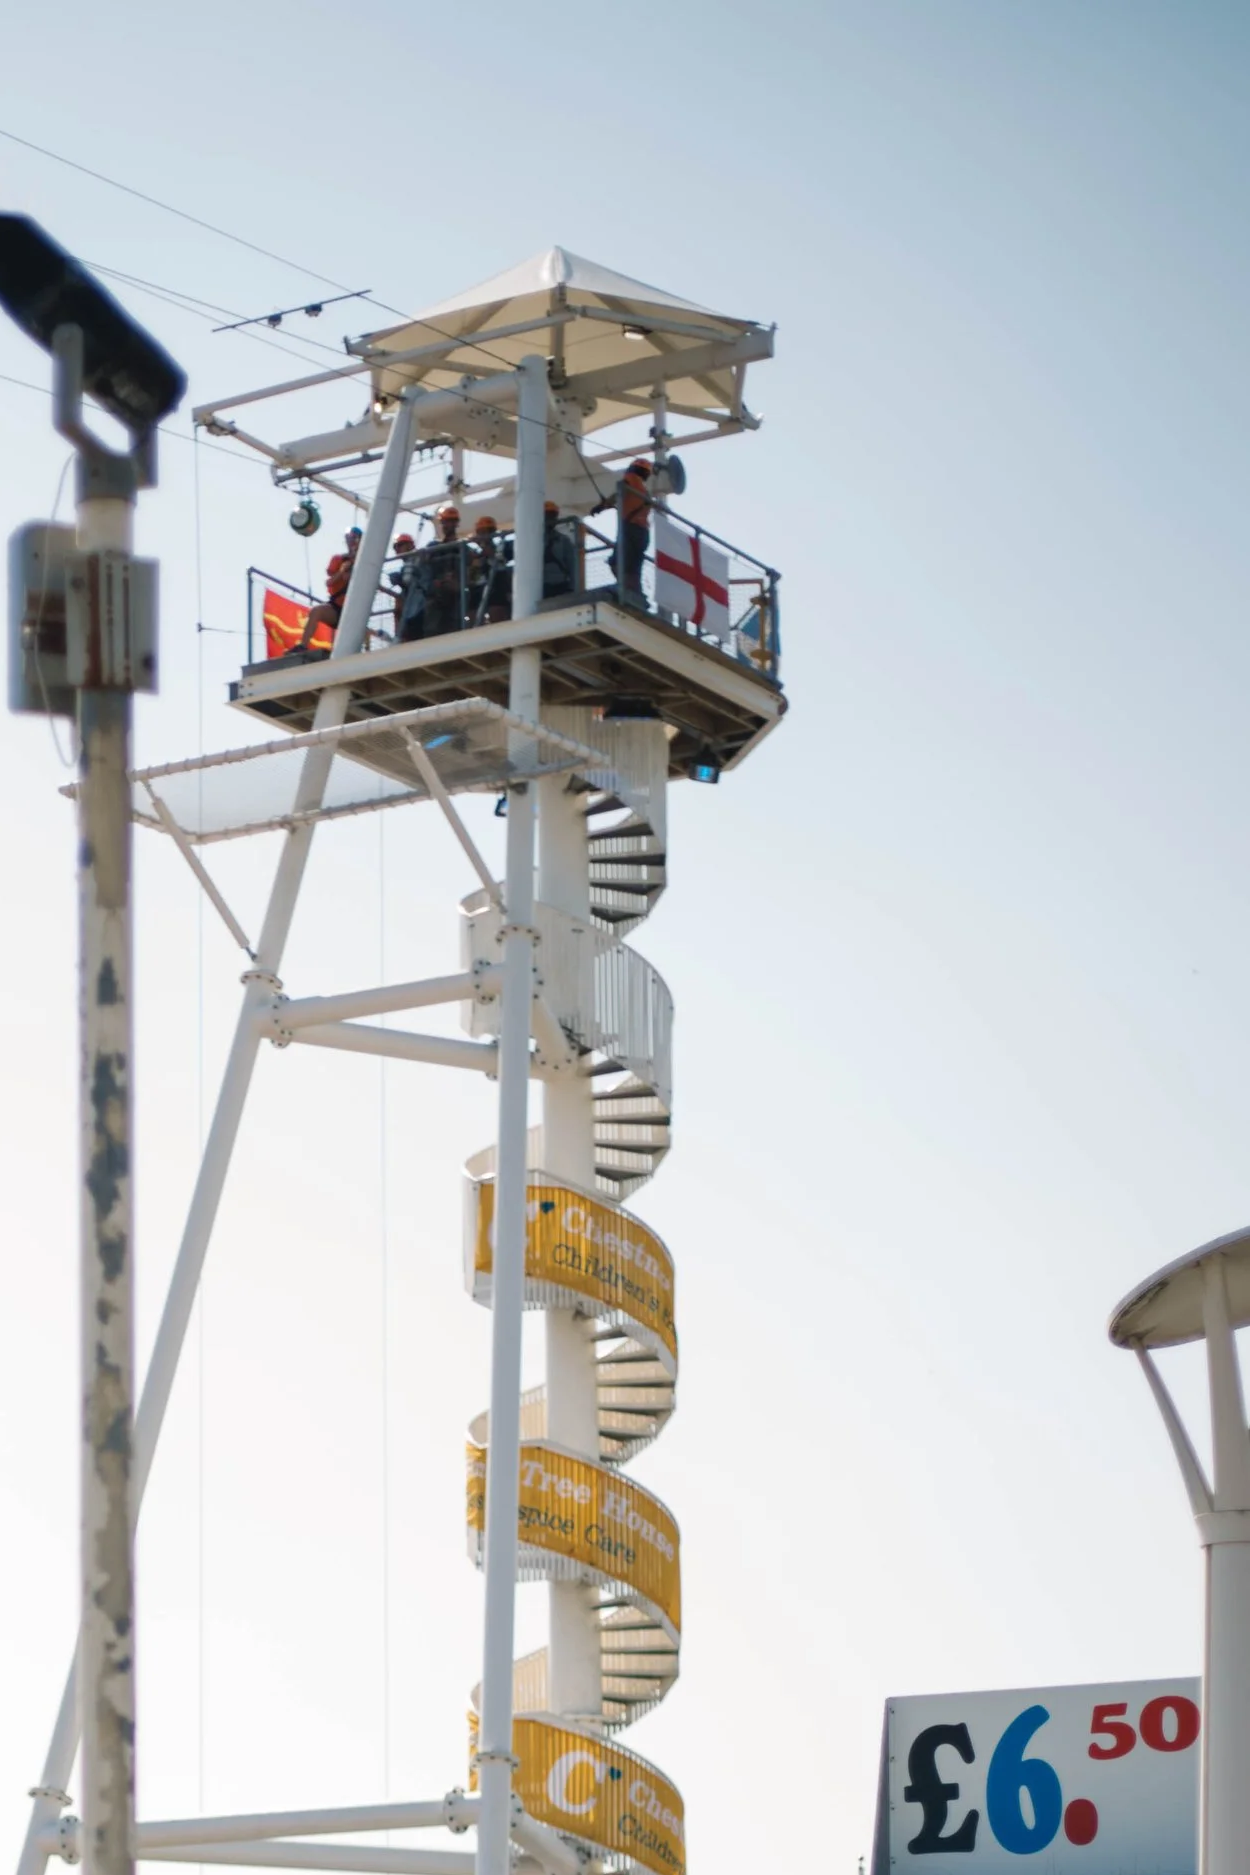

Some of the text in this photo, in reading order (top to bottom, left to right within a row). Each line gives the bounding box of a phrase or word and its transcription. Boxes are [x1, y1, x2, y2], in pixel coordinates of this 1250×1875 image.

[521, 1459, 676, 1563] Tree House
[584, 1523, 636, 1565] Care
